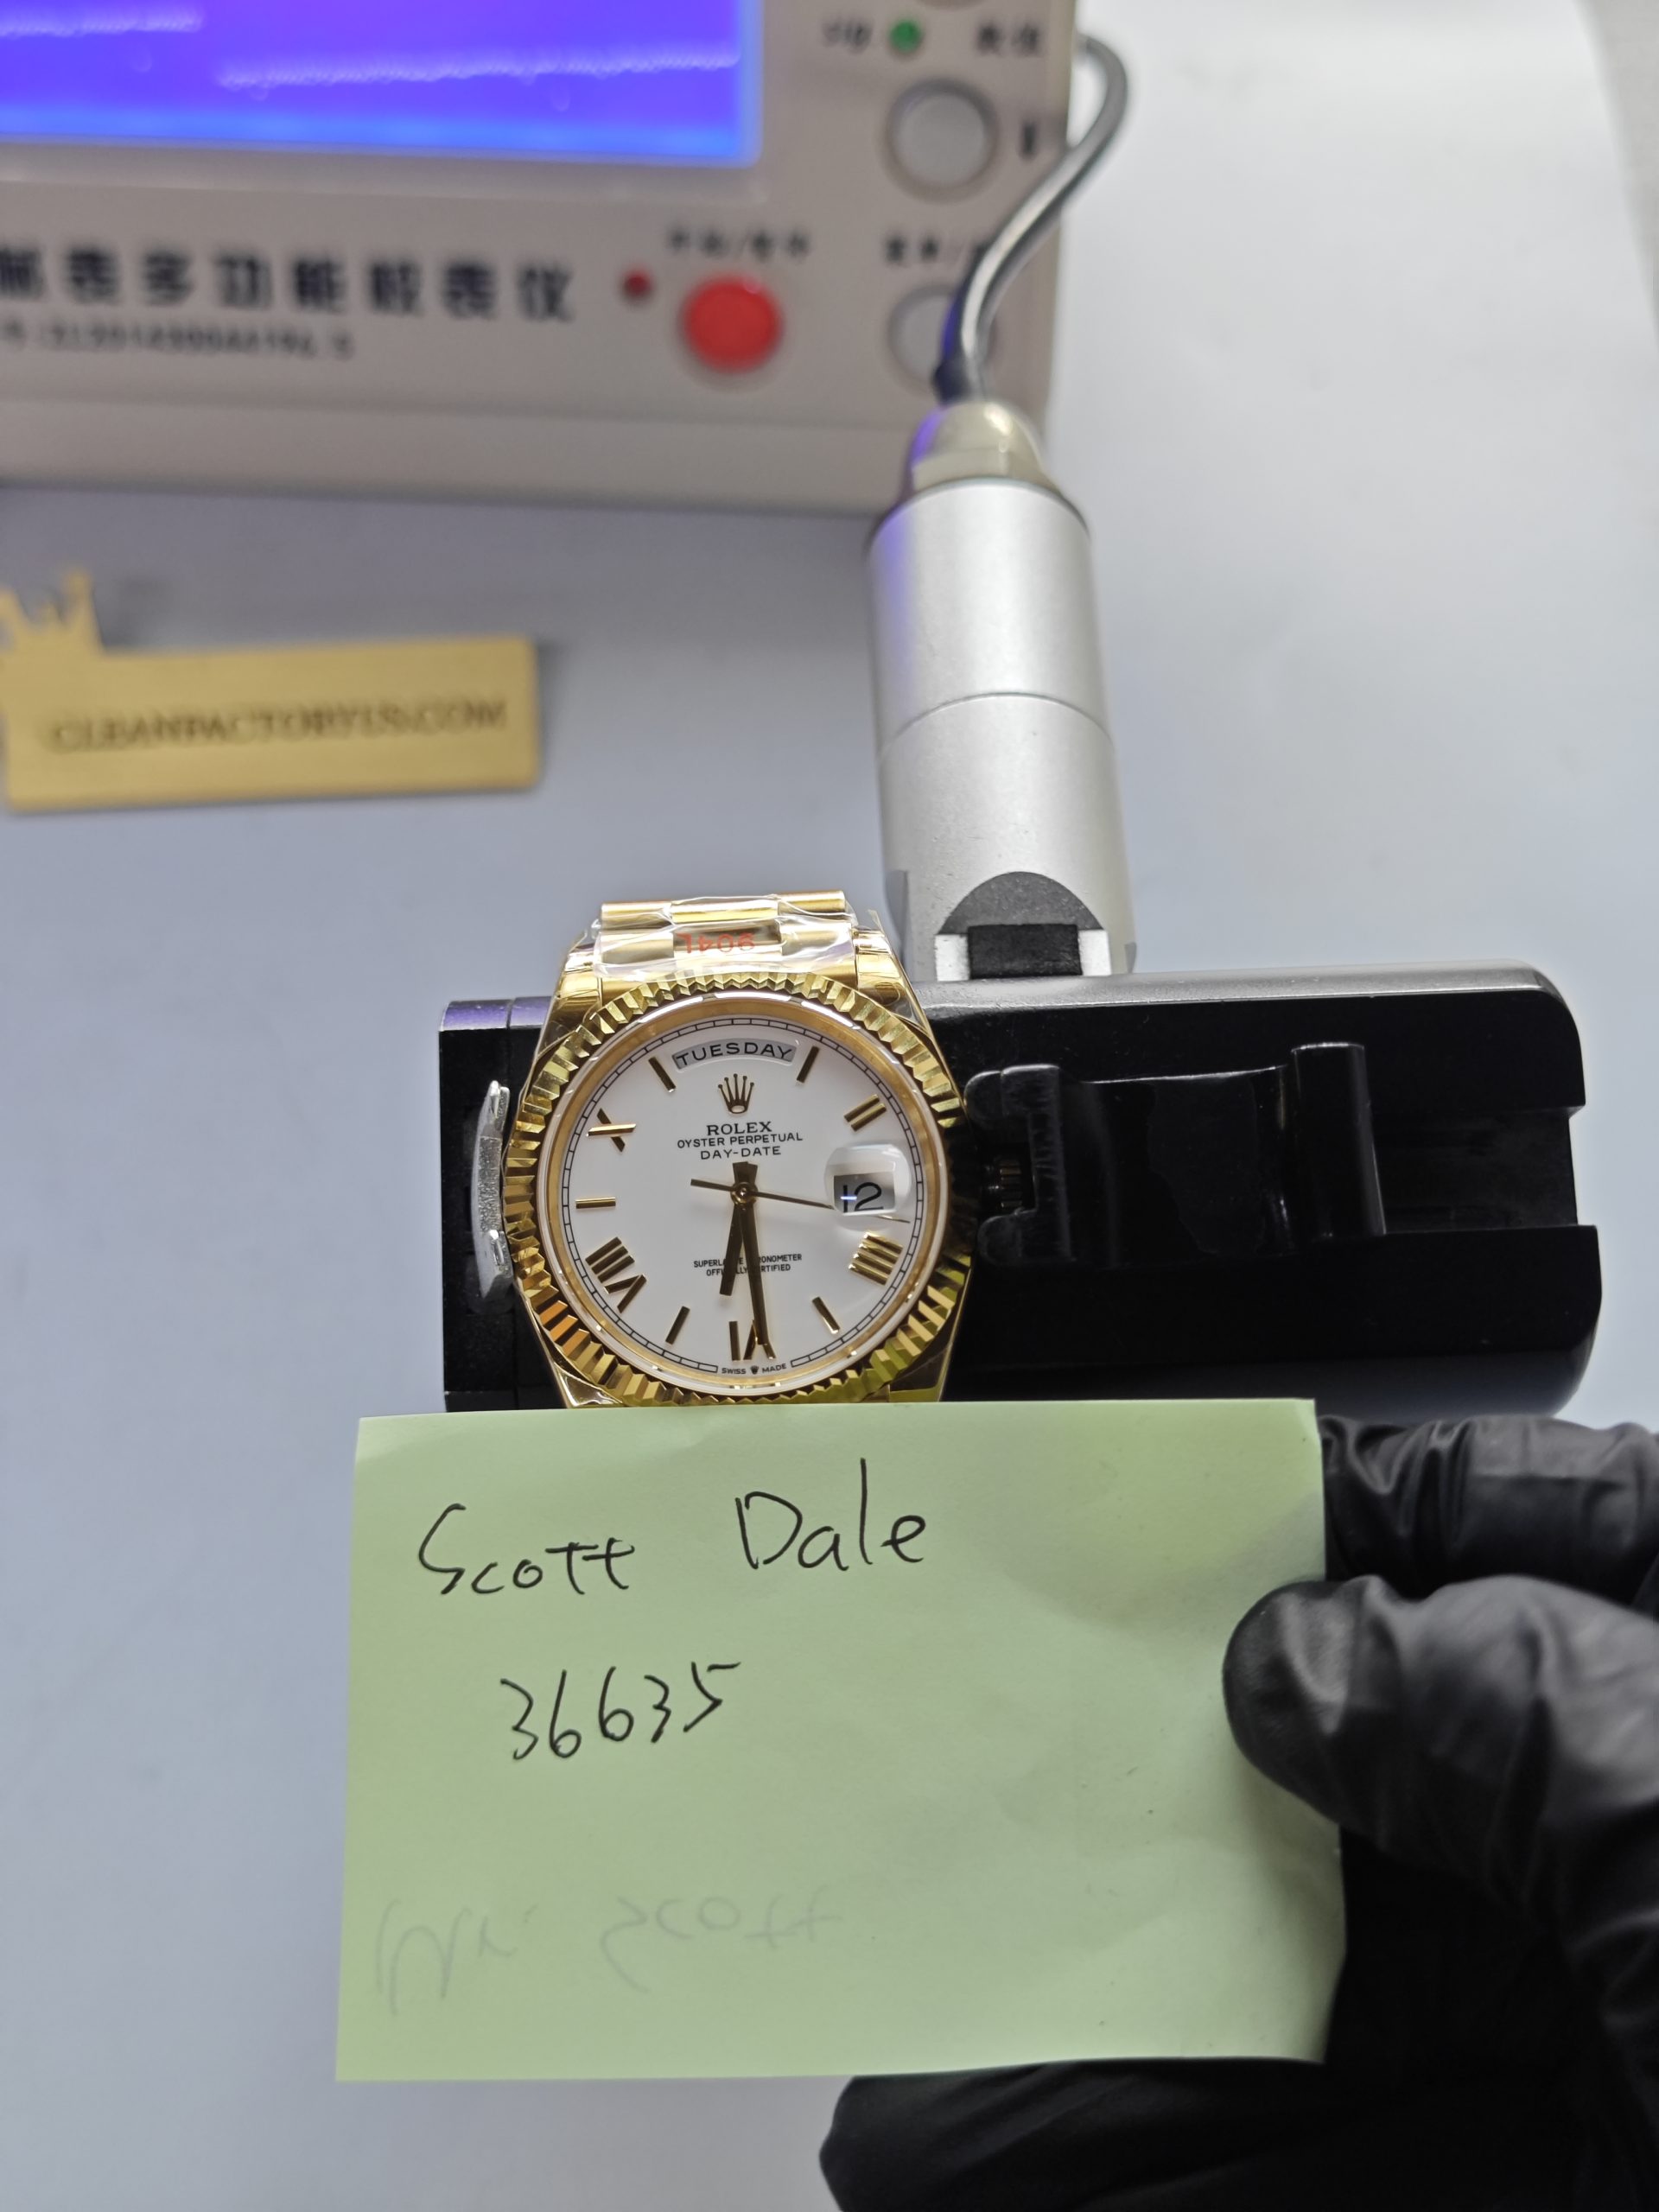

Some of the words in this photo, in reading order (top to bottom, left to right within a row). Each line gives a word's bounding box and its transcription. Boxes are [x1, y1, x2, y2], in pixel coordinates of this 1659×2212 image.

[676, 1042, 792, 1066] TUESDAY
[707, 1122, 772, 1136] ROLEX
[677, 1137, 725, 1149] OYSTER
[730, 1132, 804, 1145] PERPETUAL
[701, 1146, 781, 1160] DAY-DATE
[841, 1181, 885, 1213] 12
[752, 1263, 791, 1273] RTIFIED
[762, 1363, 787, 1374] MADE
[734, 1457, 928, 1572] Dale
[499, 1661, 742, 1760] 36635
